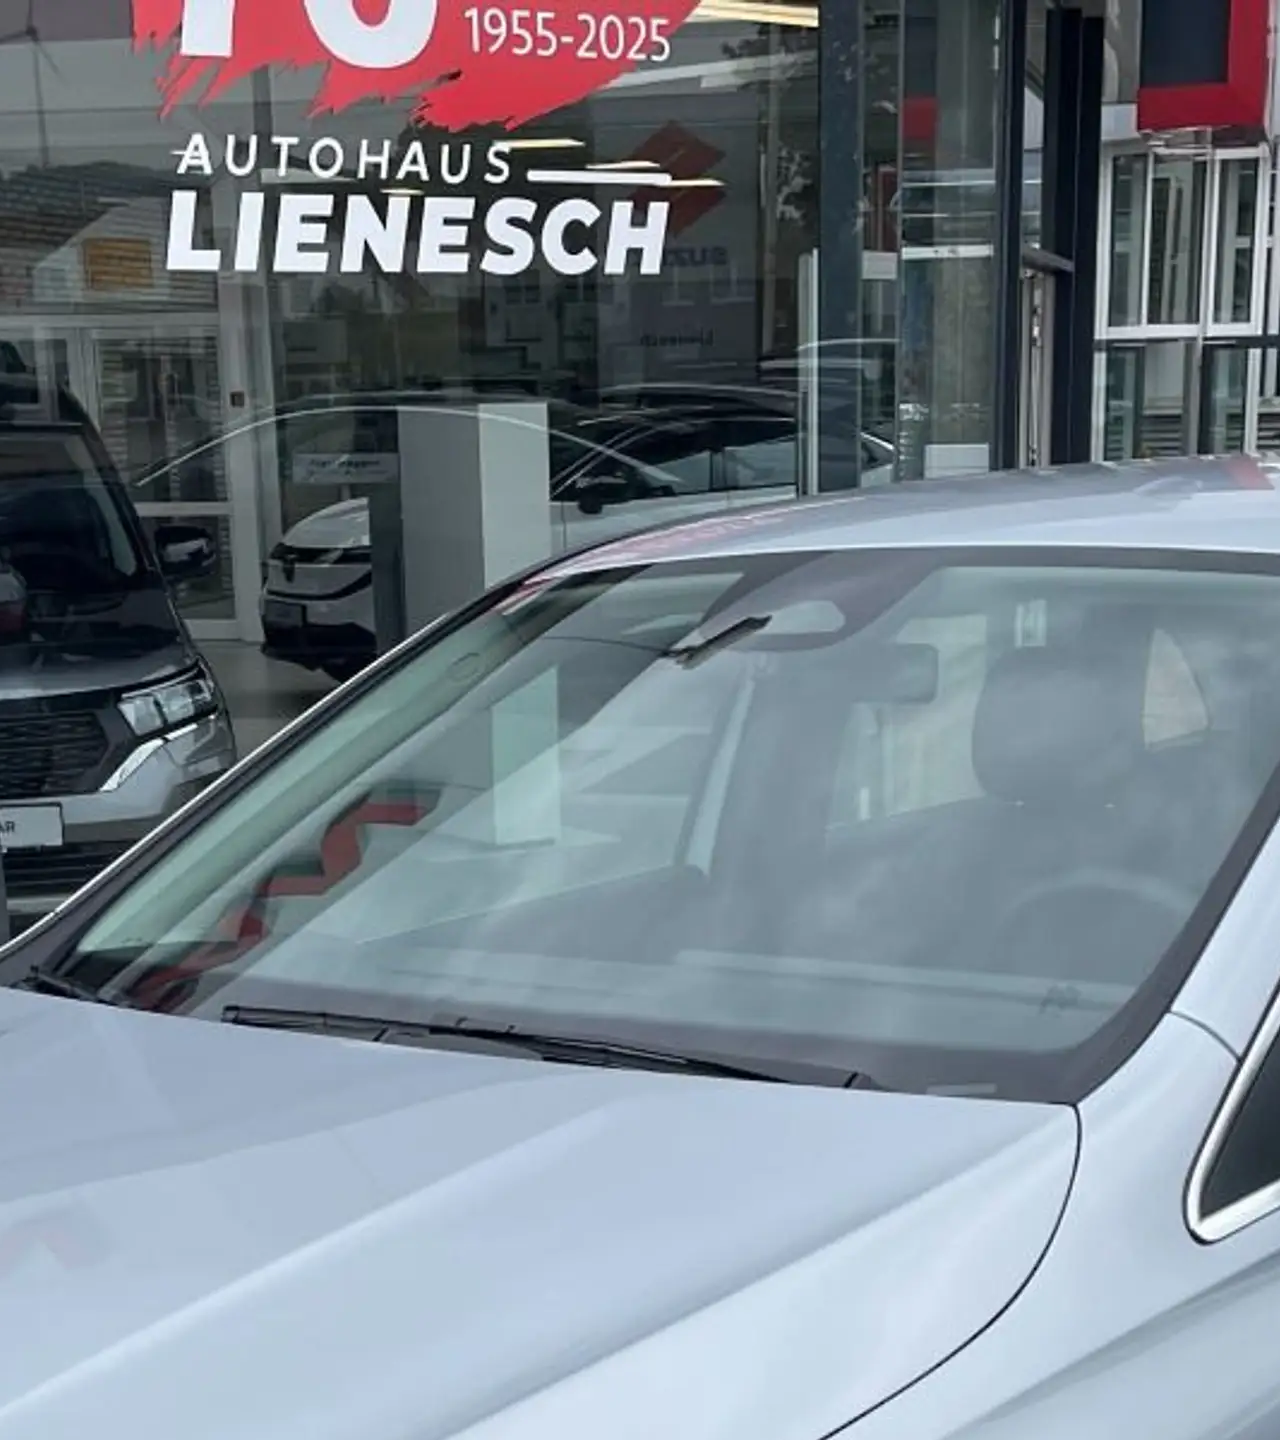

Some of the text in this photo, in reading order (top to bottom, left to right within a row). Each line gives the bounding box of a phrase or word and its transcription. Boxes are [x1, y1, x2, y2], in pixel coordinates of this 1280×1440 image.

[463, 7, 672, 62] 1955-2025
[176, 133, 512, 185] AUTOHAUS
[166, 189, 670, 276] LIENESCH
